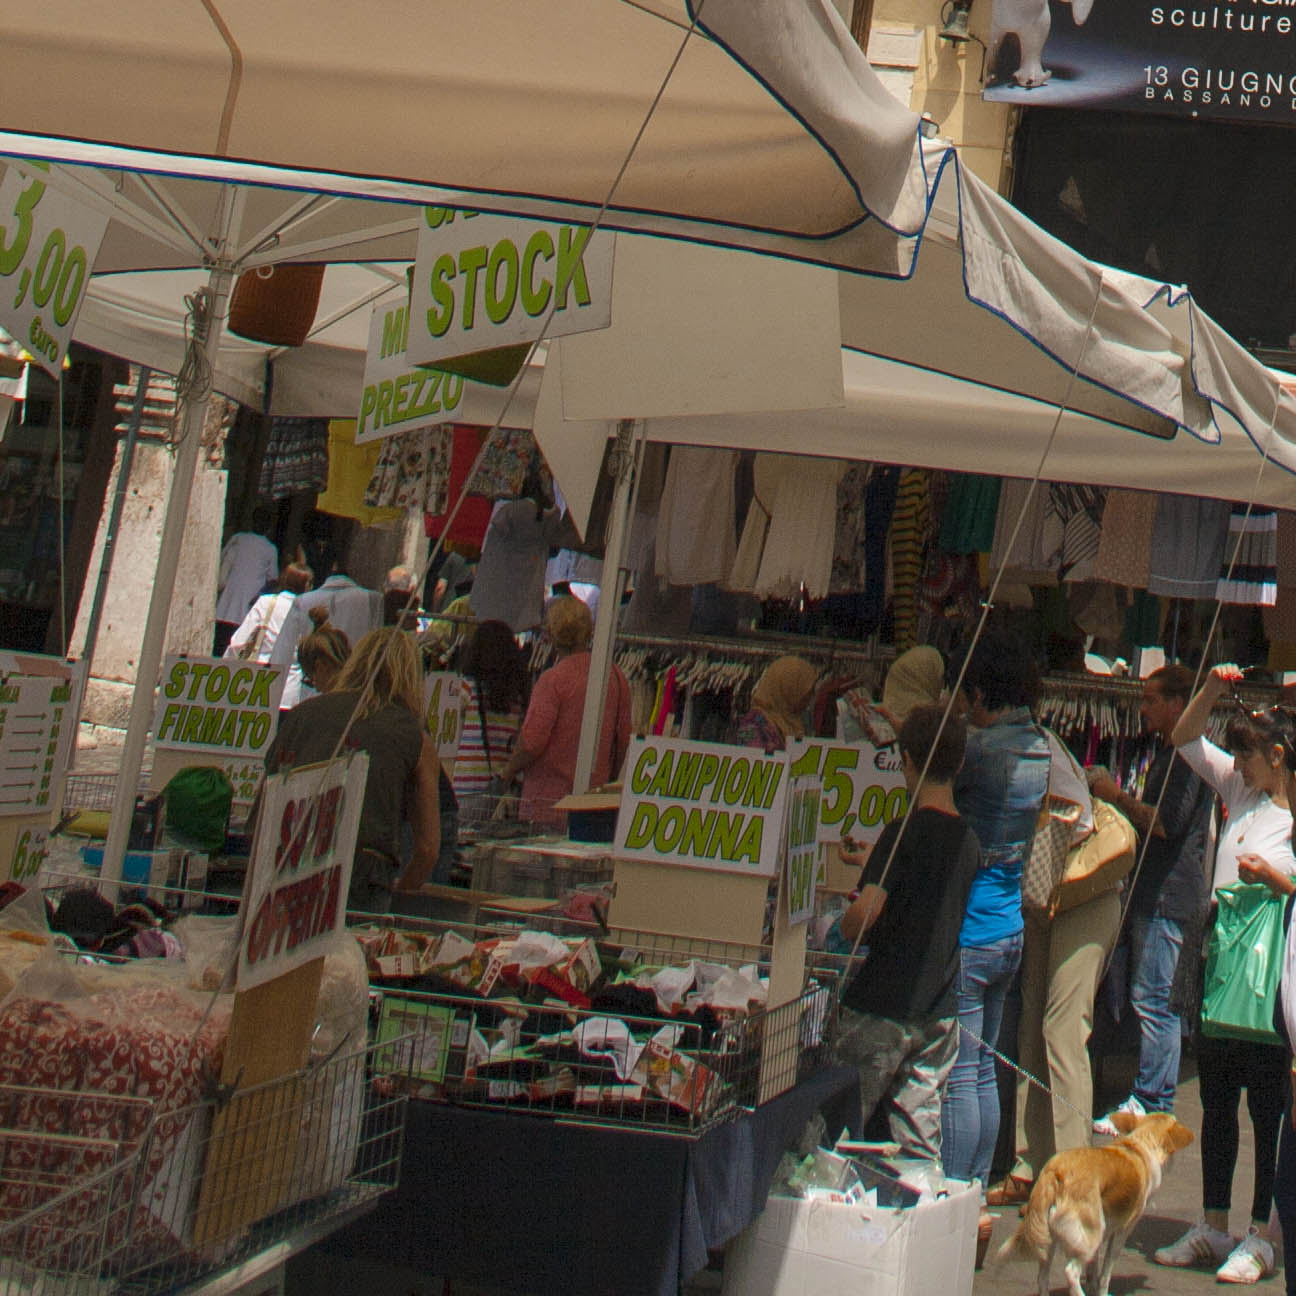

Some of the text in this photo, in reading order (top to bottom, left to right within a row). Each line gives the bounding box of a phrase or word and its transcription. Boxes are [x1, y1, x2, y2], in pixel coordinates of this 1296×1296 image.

[1151, 7, 1292, 34] sculture
[1143, 65, 1169, 86] 13
[1145, 86, 1272, 108] BASSANO
[426, 225, 592, 338] STOCK
[358, 369, 465, 435] PREZZO
[165, 661, 281, 708] STOCK
[157, 702, 272, 750] FIRMATO
[631, 745, 785, 810] CAMPIONI
[624, 800, 765, 866] DONNA
